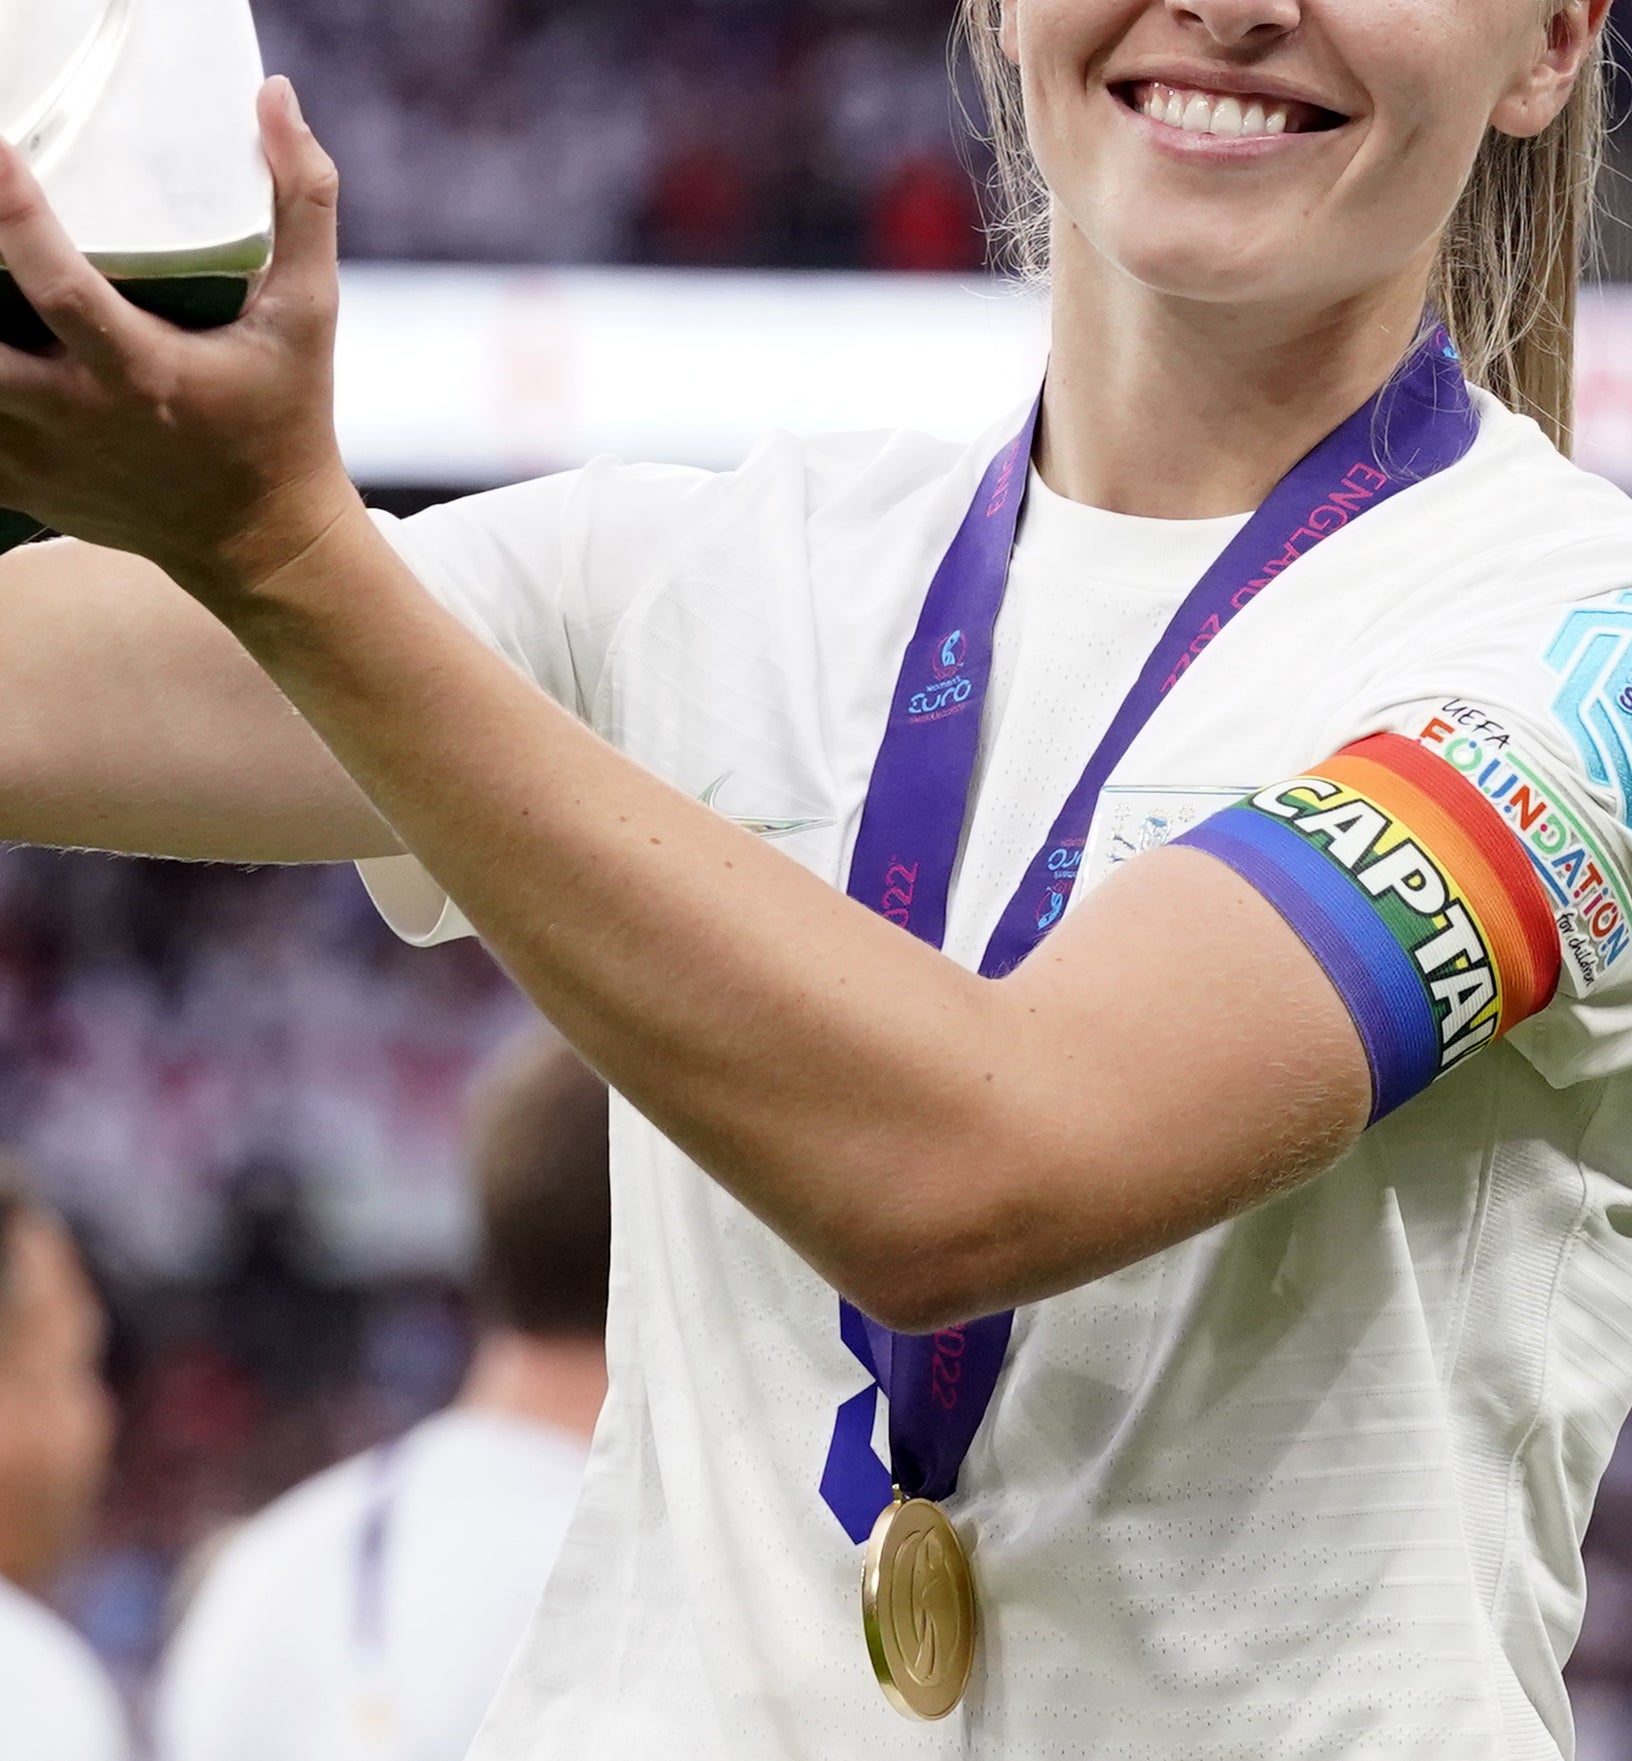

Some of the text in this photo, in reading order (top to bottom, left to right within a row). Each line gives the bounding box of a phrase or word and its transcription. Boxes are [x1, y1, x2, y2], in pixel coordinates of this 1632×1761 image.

[1441, 698, 1511, 750] UEFA
[1419, 717, 1630, 966] FOUNDATION
[881, 862, 918, 928] 022
[1248, 777, 1498, 1083] CAPTAI
[1568, 938, 1598, 988] children
[932, 1324, 967, 1409] 022
